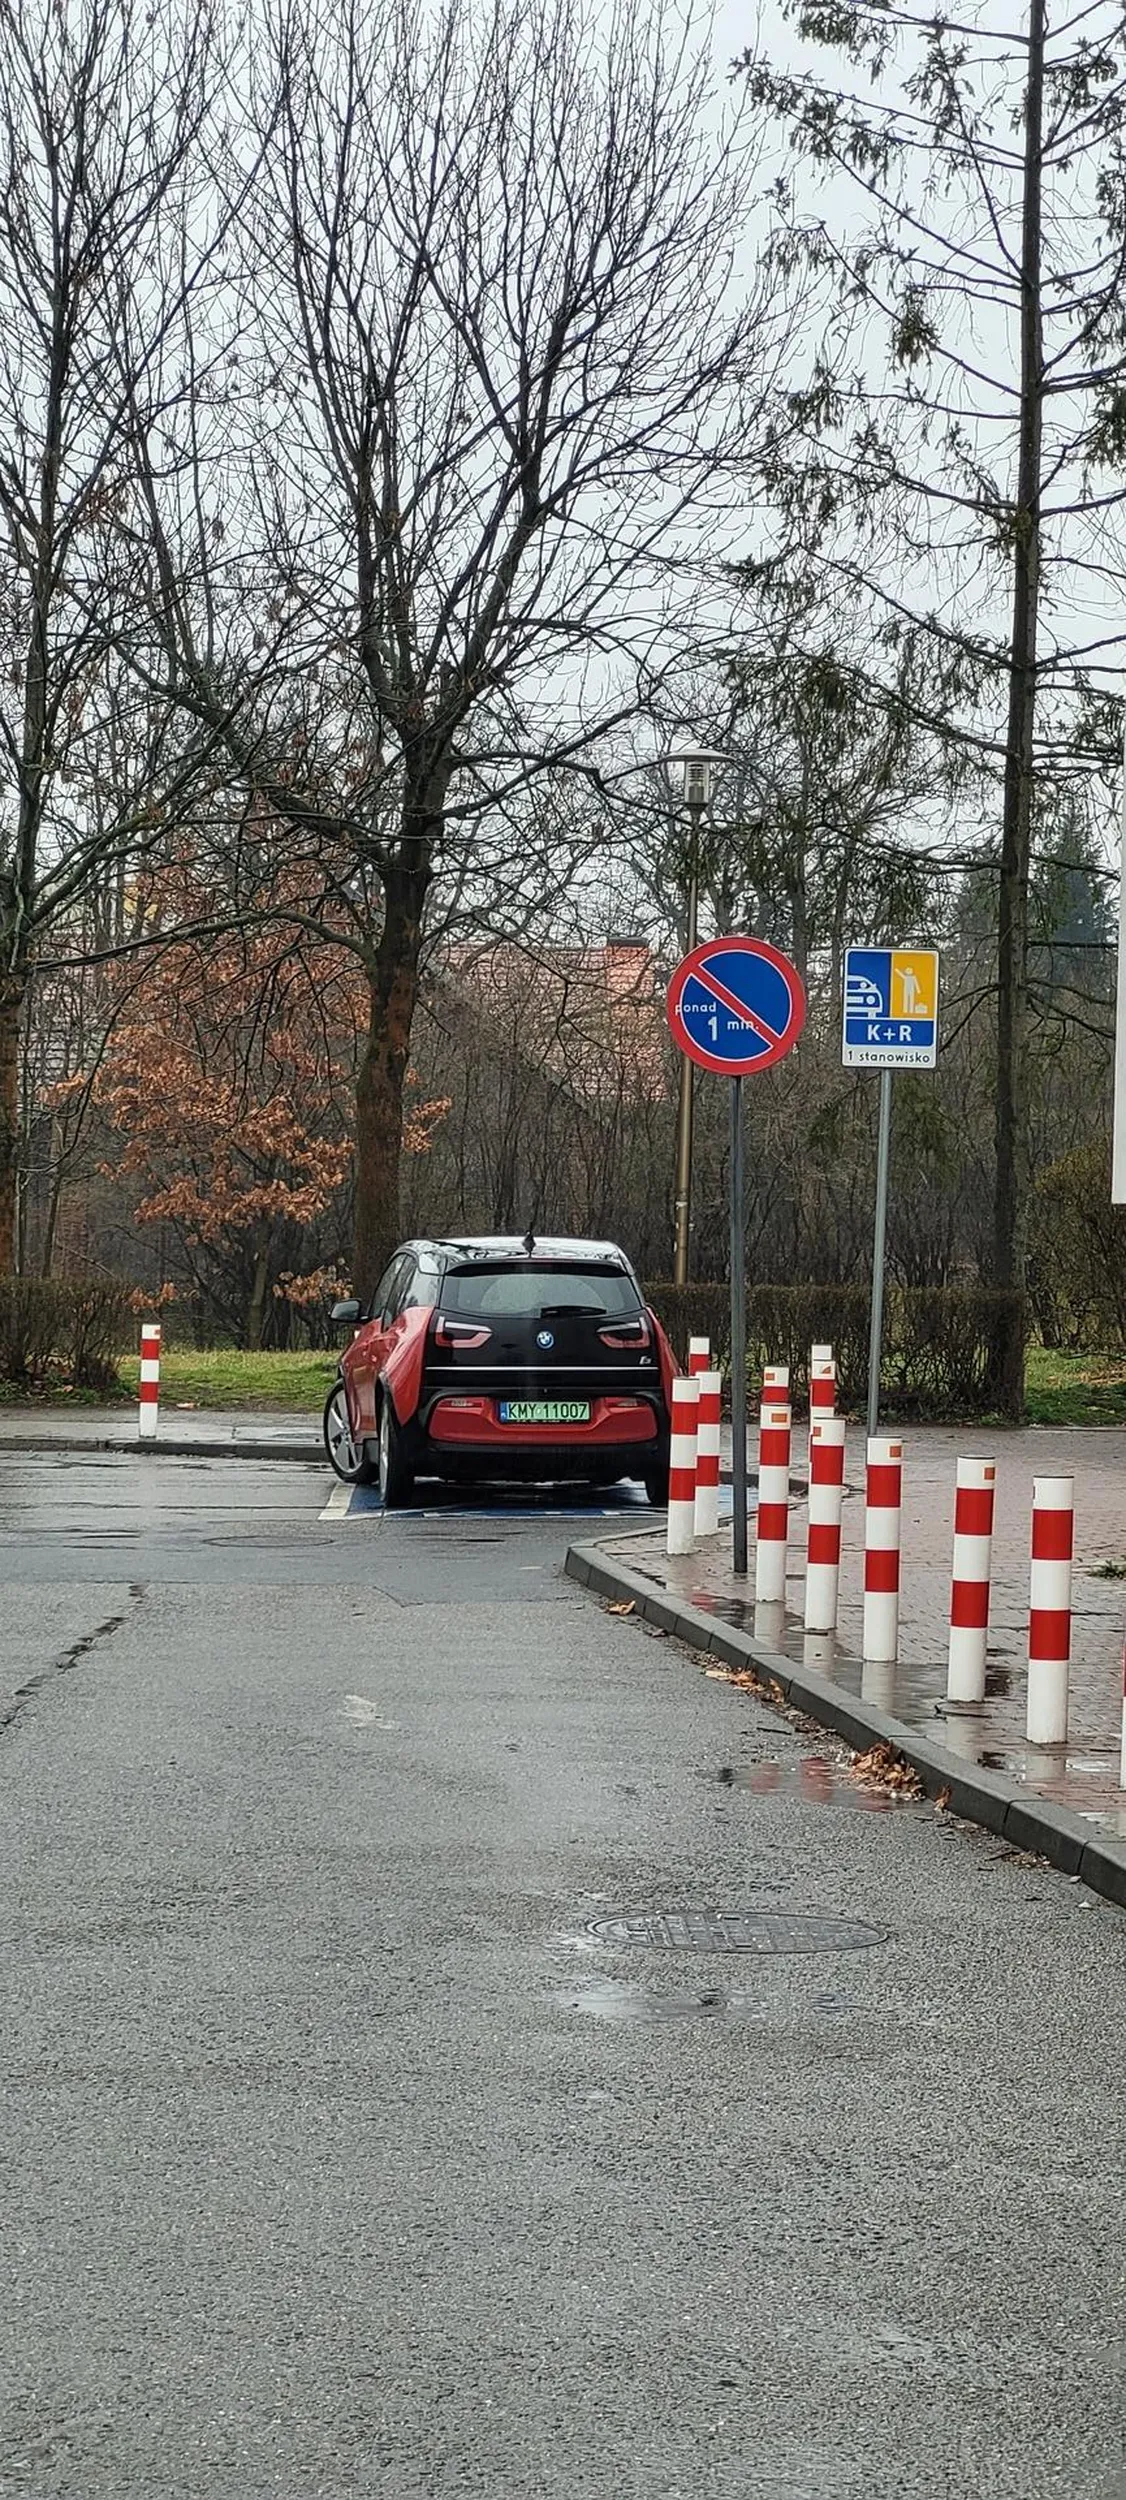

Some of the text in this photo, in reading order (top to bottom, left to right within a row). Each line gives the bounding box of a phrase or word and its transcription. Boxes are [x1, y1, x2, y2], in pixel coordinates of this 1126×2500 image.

[675, 1002, 717, 1016] ponad
[708, 1016, 760, 1041] 1 min.
[867, 1024, 912, 1042] K+R
[848, 1050, 931, 1063] 1 stanowisko
[508, 1403, 588, 1418] KMY 11007
